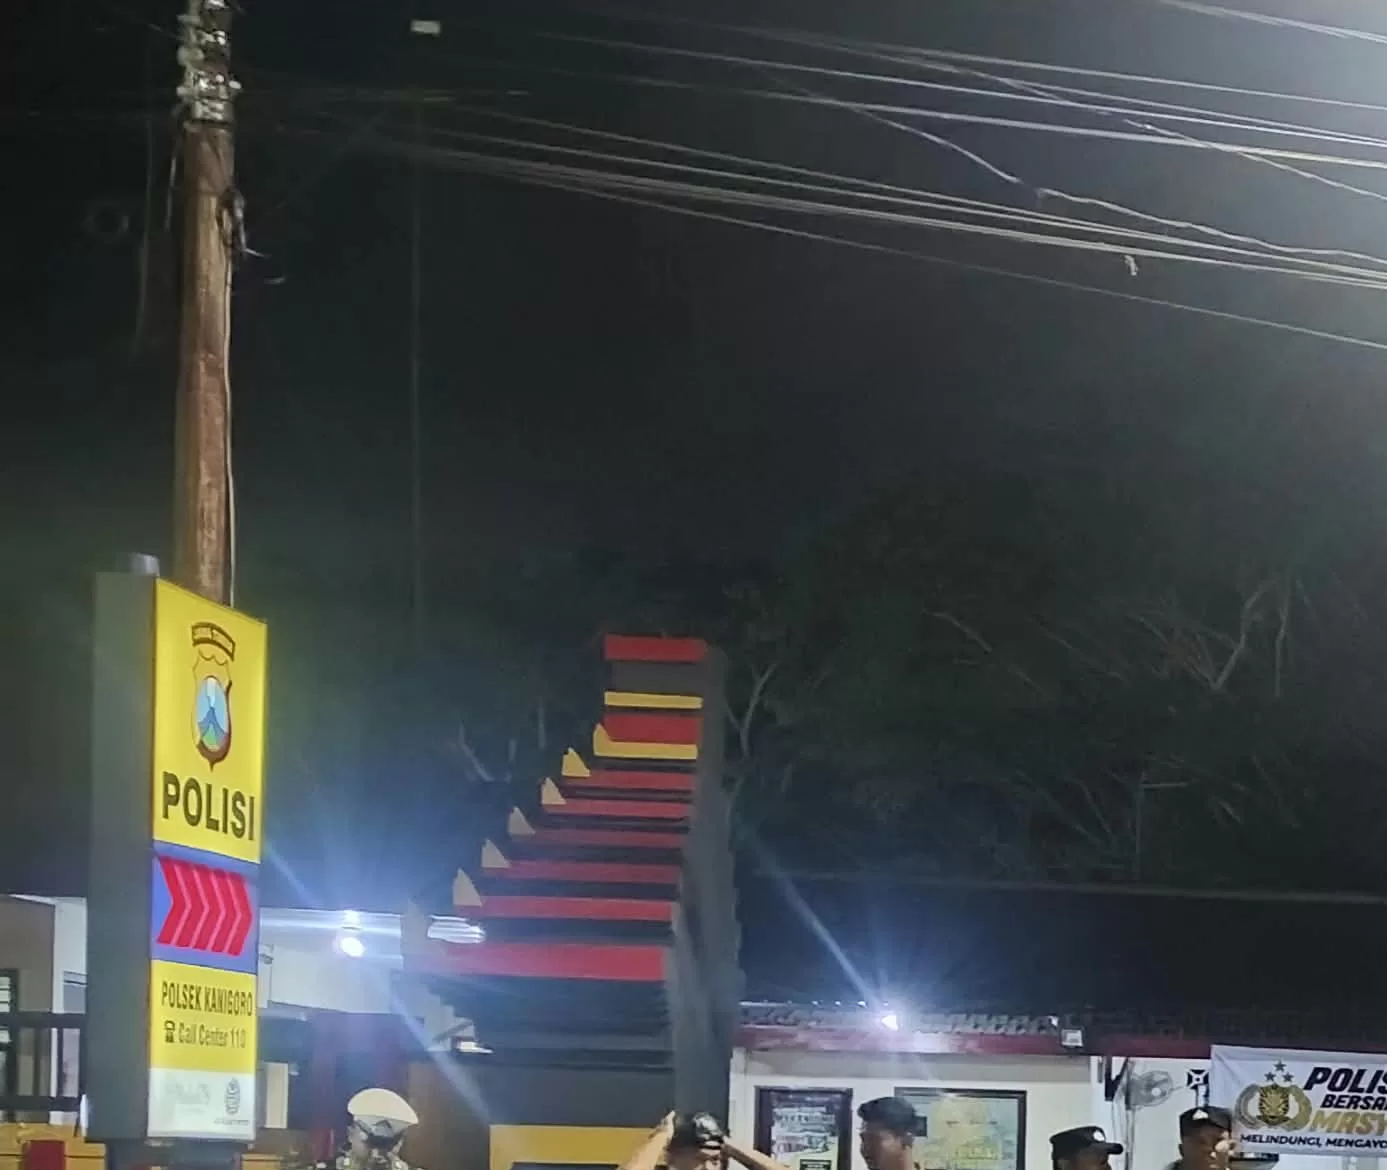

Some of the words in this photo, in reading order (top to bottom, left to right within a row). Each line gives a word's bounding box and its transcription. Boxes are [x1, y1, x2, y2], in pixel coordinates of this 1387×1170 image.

[162, 771, 255, 841] POLISI
[161, 981, 201, 1011] POLSEK
[204, 986, 253, 1016] KANIGORO
[178, 1022, 197, 1044] Call
[199, 1024, 228, 1047] Center
[230, 1028, 246, 1049] 110
